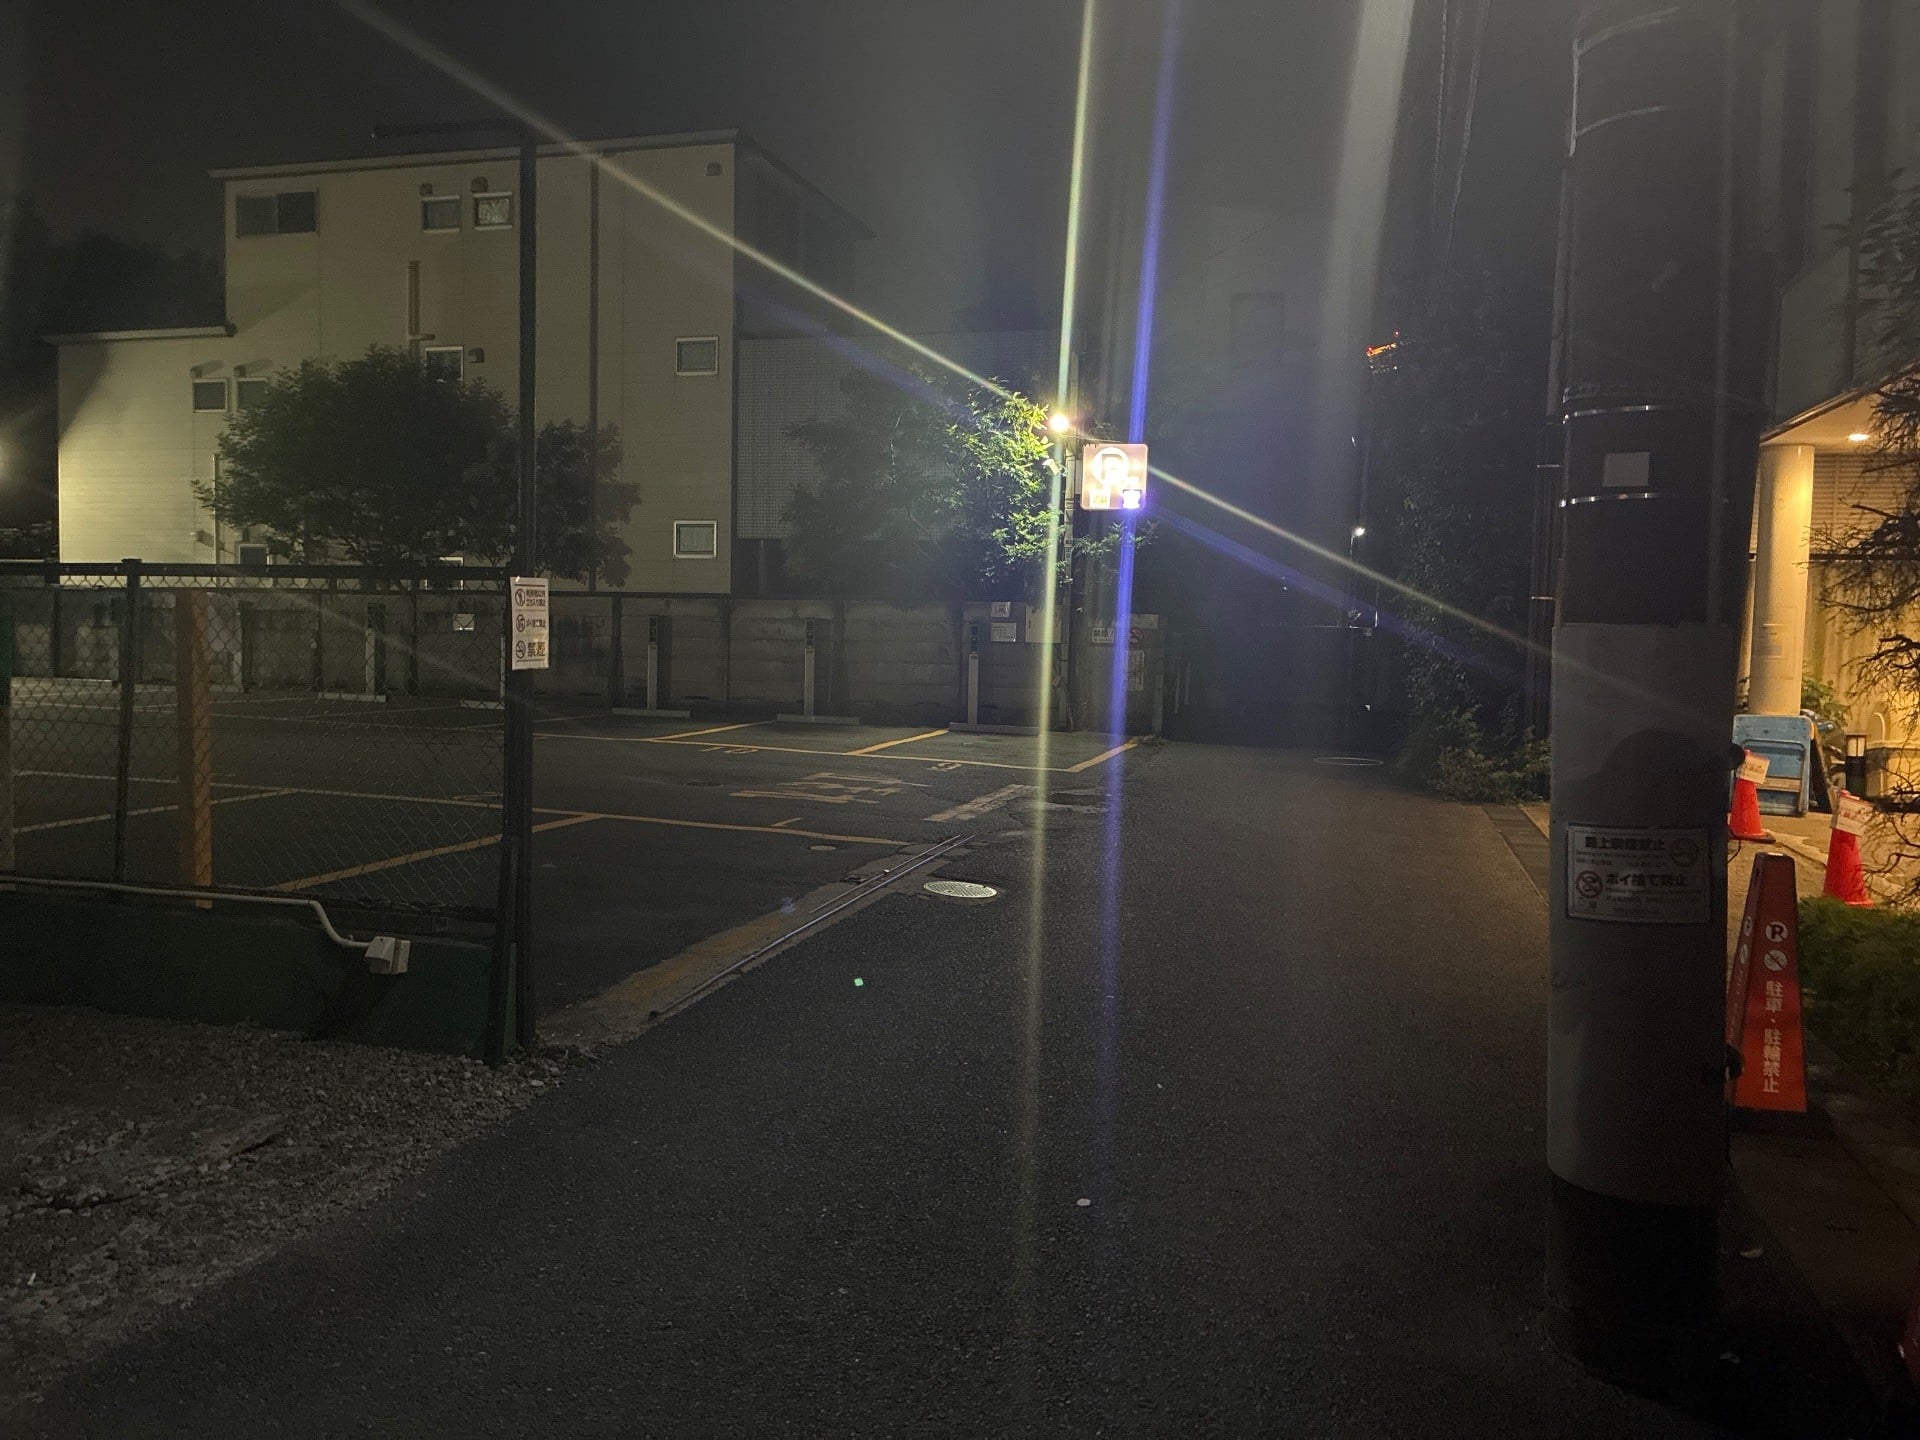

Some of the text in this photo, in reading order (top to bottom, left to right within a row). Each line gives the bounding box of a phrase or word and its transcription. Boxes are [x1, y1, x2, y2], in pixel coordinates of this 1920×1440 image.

[1762, 979, 1784, 1093] 駐車・駐輪禁止
